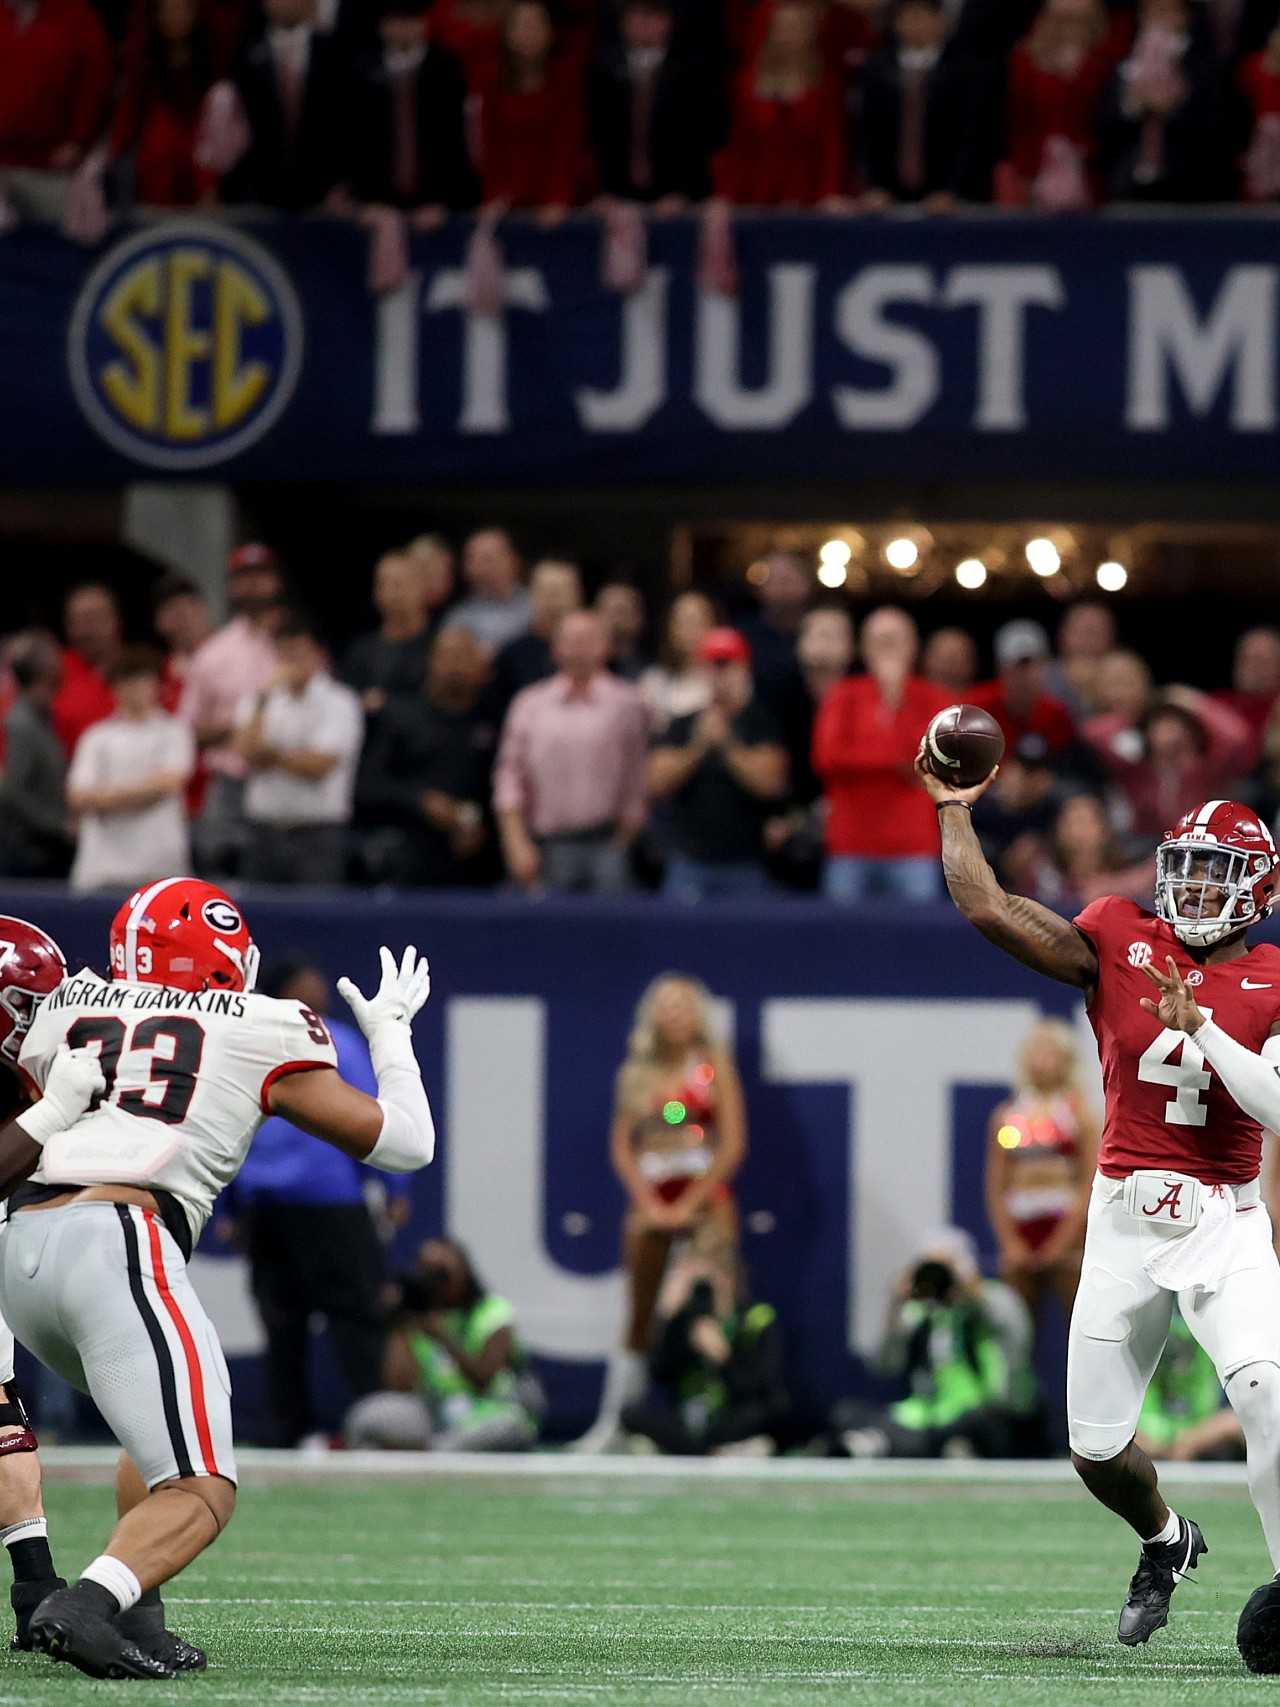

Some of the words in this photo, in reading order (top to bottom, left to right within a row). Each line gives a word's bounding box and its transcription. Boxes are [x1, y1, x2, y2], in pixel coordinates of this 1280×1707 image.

[98, 250, 271, 440] SEC
[371, 270, 550, 434] IT
[577, 260, 1064, 433] JUST
[203, 900, 242, 934] G
[48, 980, 248, 1018] INGRAM-DAWKINS
[299, 1008, 334, 1046] 9
[1138, 1005, 1214, 1127] 4
